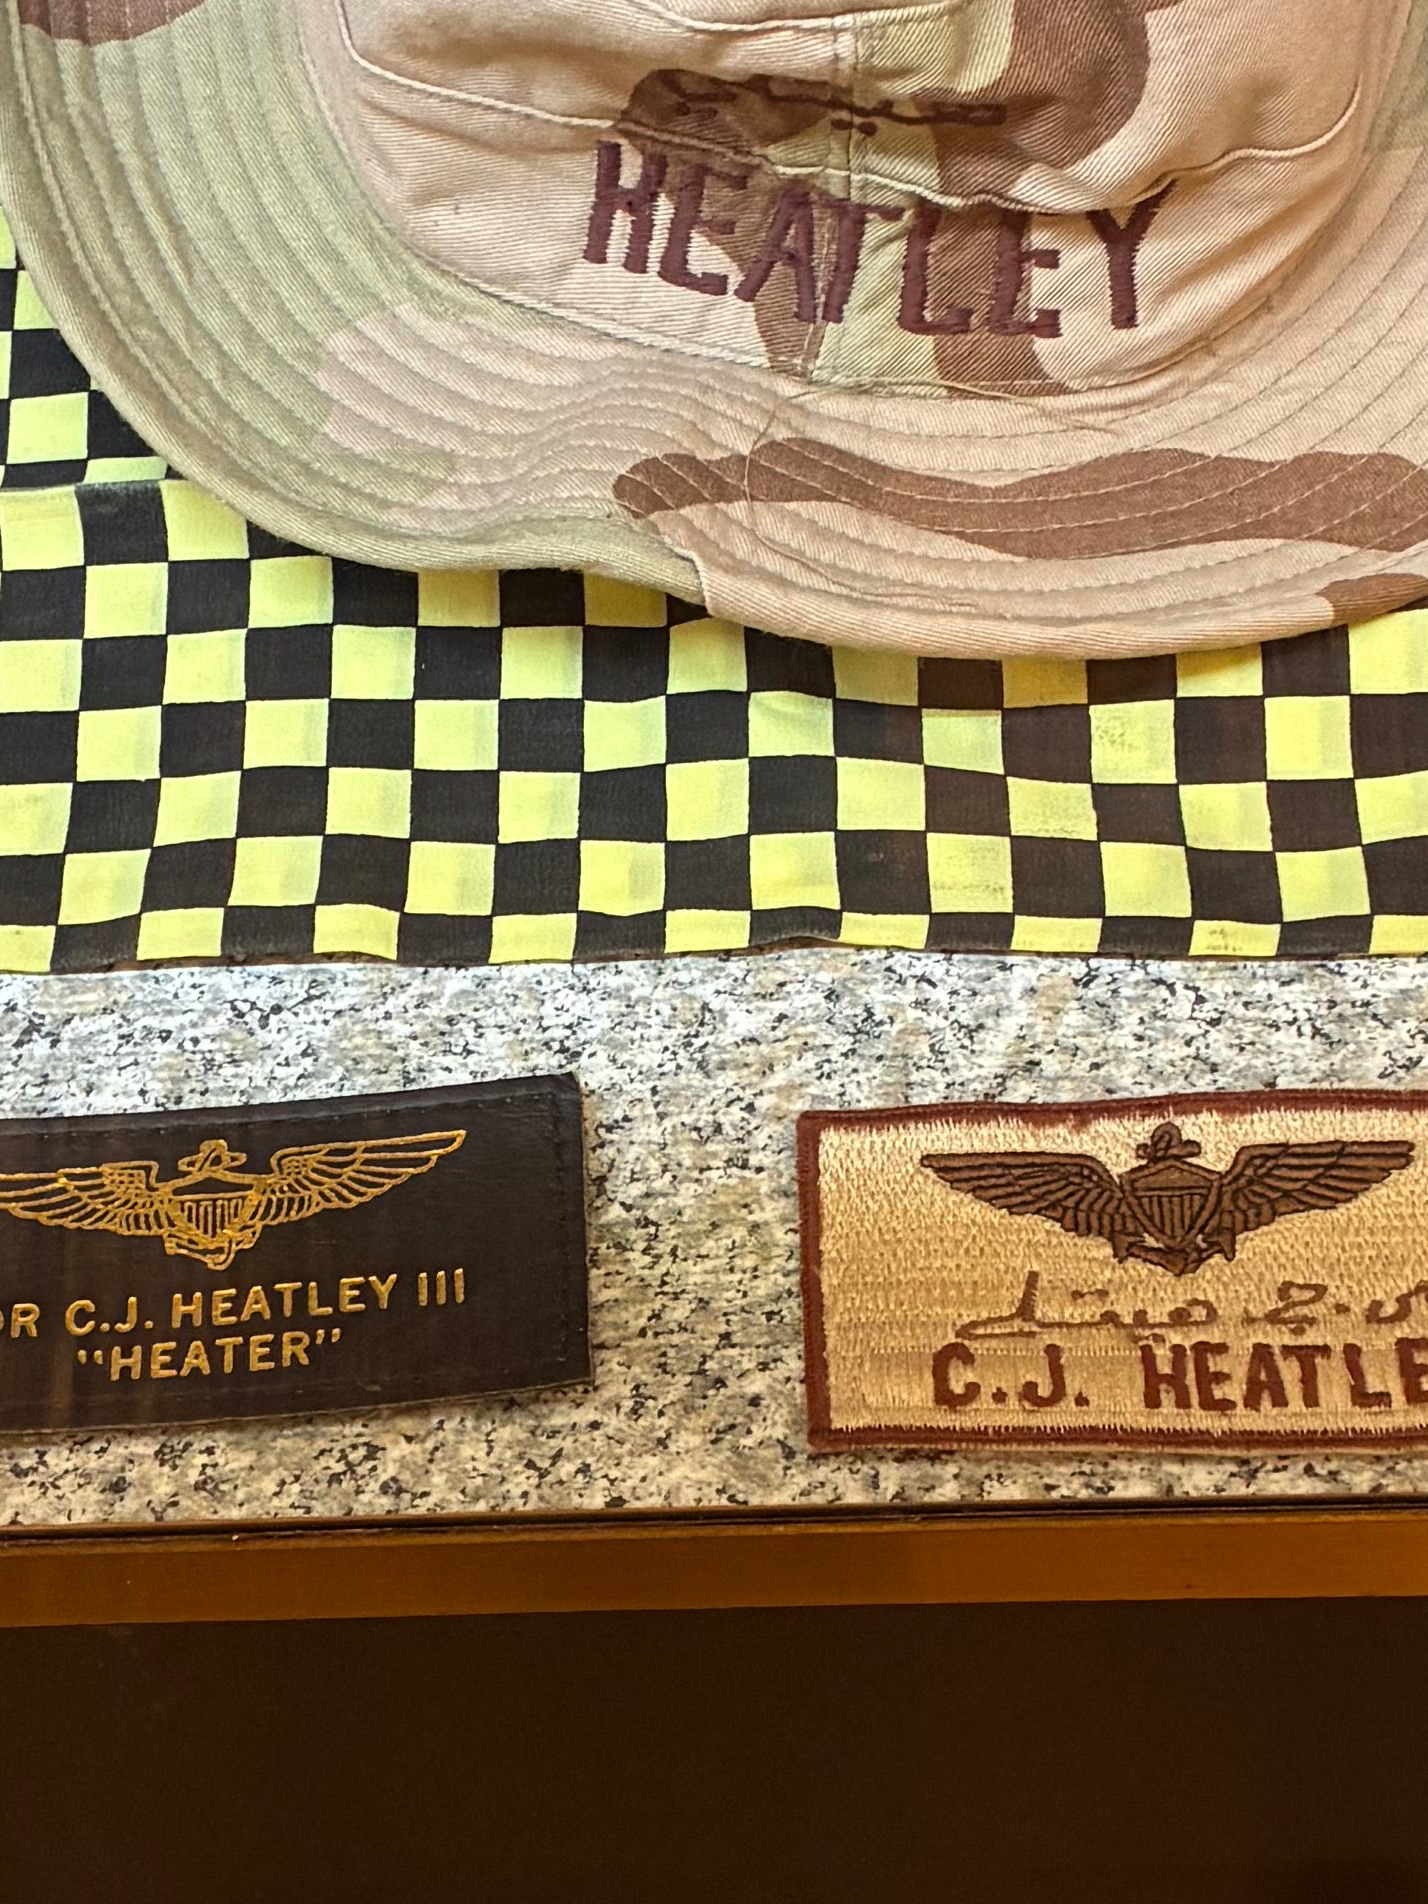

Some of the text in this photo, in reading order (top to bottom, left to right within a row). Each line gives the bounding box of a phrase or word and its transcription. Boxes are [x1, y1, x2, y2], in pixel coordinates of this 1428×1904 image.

[582, 141, 1178, 339] HEATLEY
[65, 1296, 154, 1337] C.J.
[171, 1272, 400, 1328] HEATLEY
[417, 1268, 467, 1307] III
[77, 1327, 344, 1382] "HEATER"
[932, 1341, 1091, 1409] C.J.
